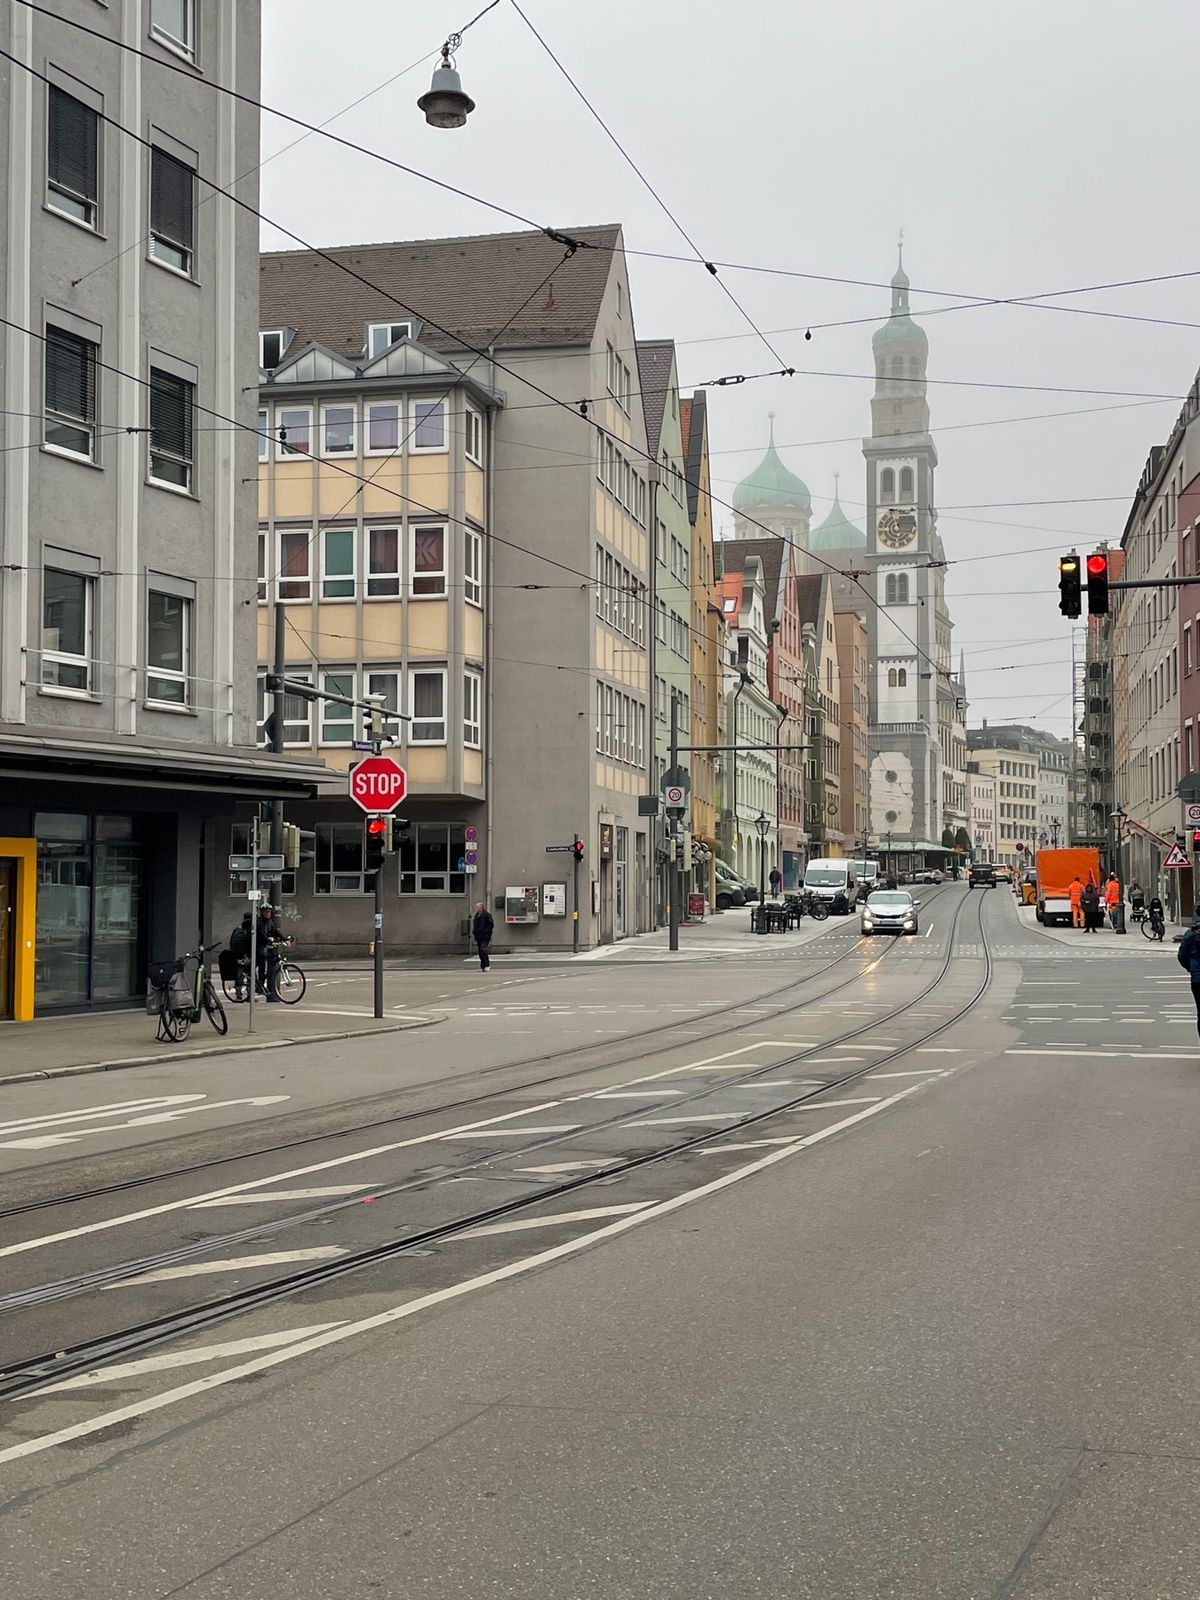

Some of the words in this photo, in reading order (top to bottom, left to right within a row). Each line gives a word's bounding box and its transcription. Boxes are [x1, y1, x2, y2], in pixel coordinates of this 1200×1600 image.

[355, 773, 402, 795] STOP
[671, 791, 680, 799] 20
[1191, 808, 1200, 816] 20
